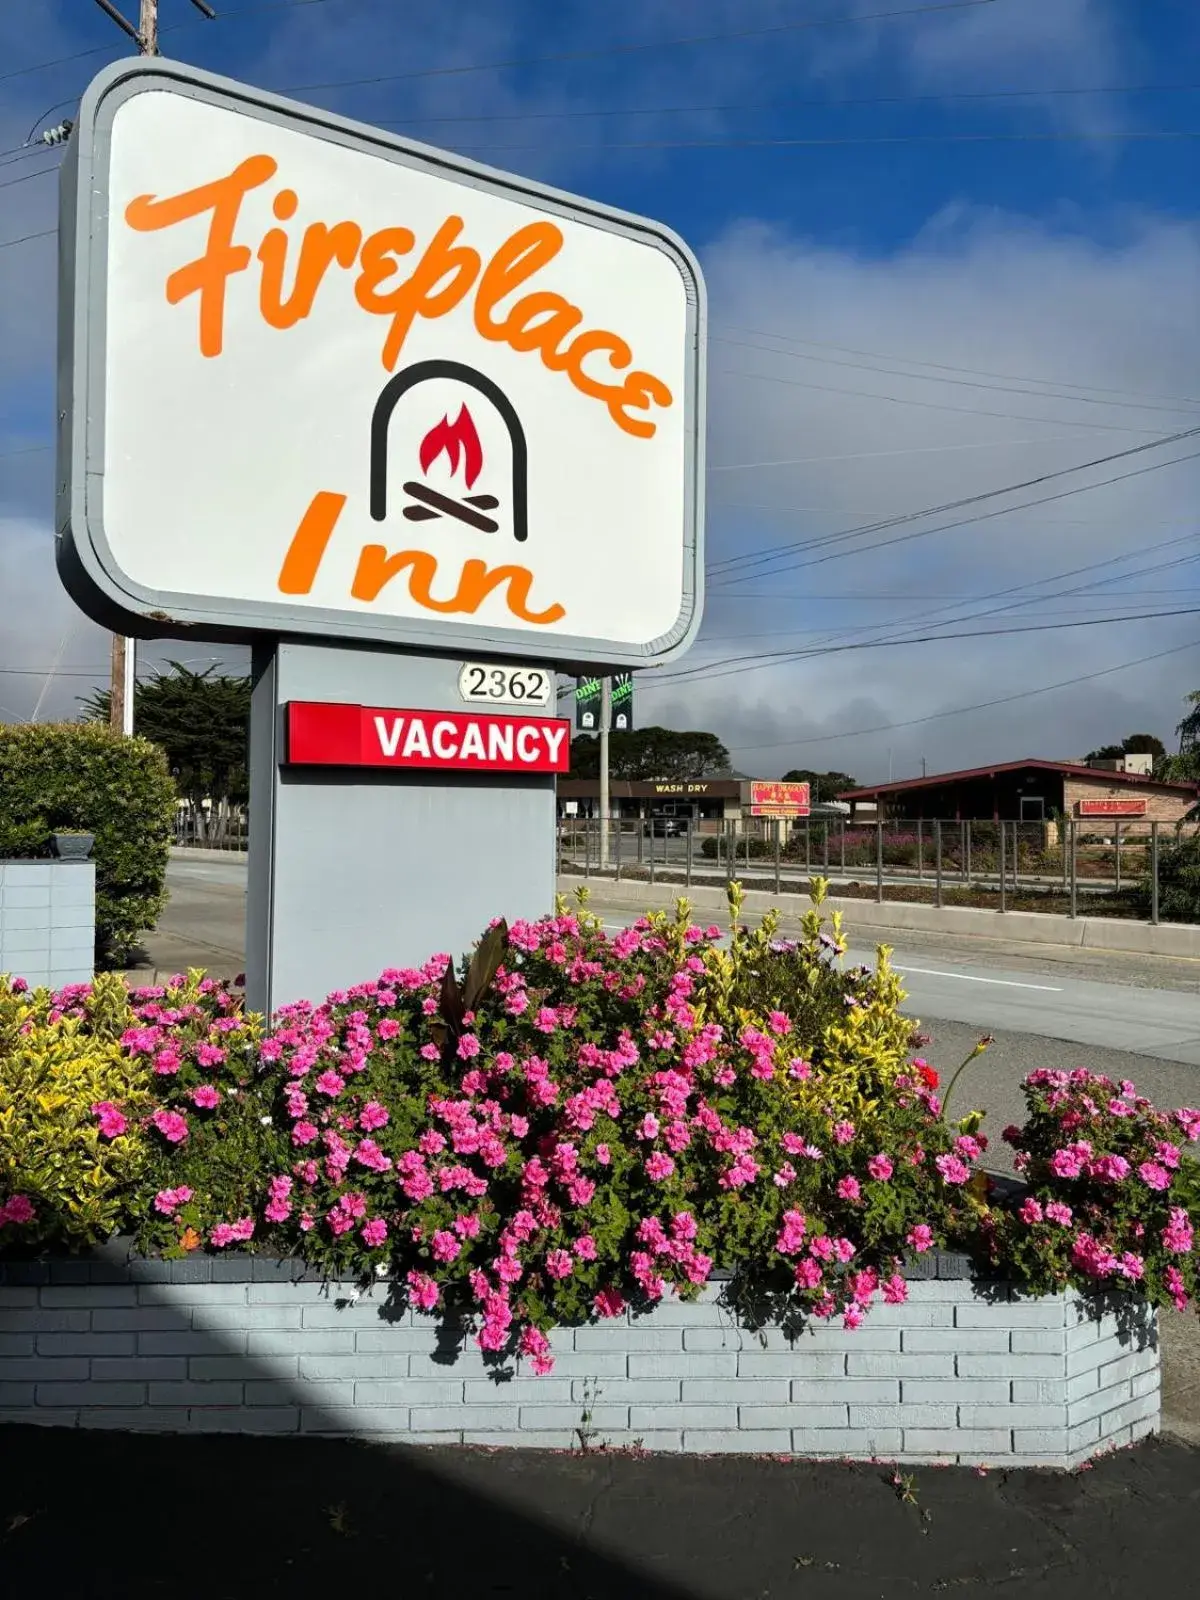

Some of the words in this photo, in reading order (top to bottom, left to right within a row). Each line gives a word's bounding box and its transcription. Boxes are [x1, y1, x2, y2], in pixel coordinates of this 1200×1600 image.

[125, 154, 673, 439] Fireplace
[278, 491, 566, 624] Inn
[469, 667, 543, 700] 2362
[575, 679, 601, 700] DINE
[374, 716, 566, 763] VACANCY
[656, 784, 683, 793] WASH
[687, 784, 708, 793] DRY
